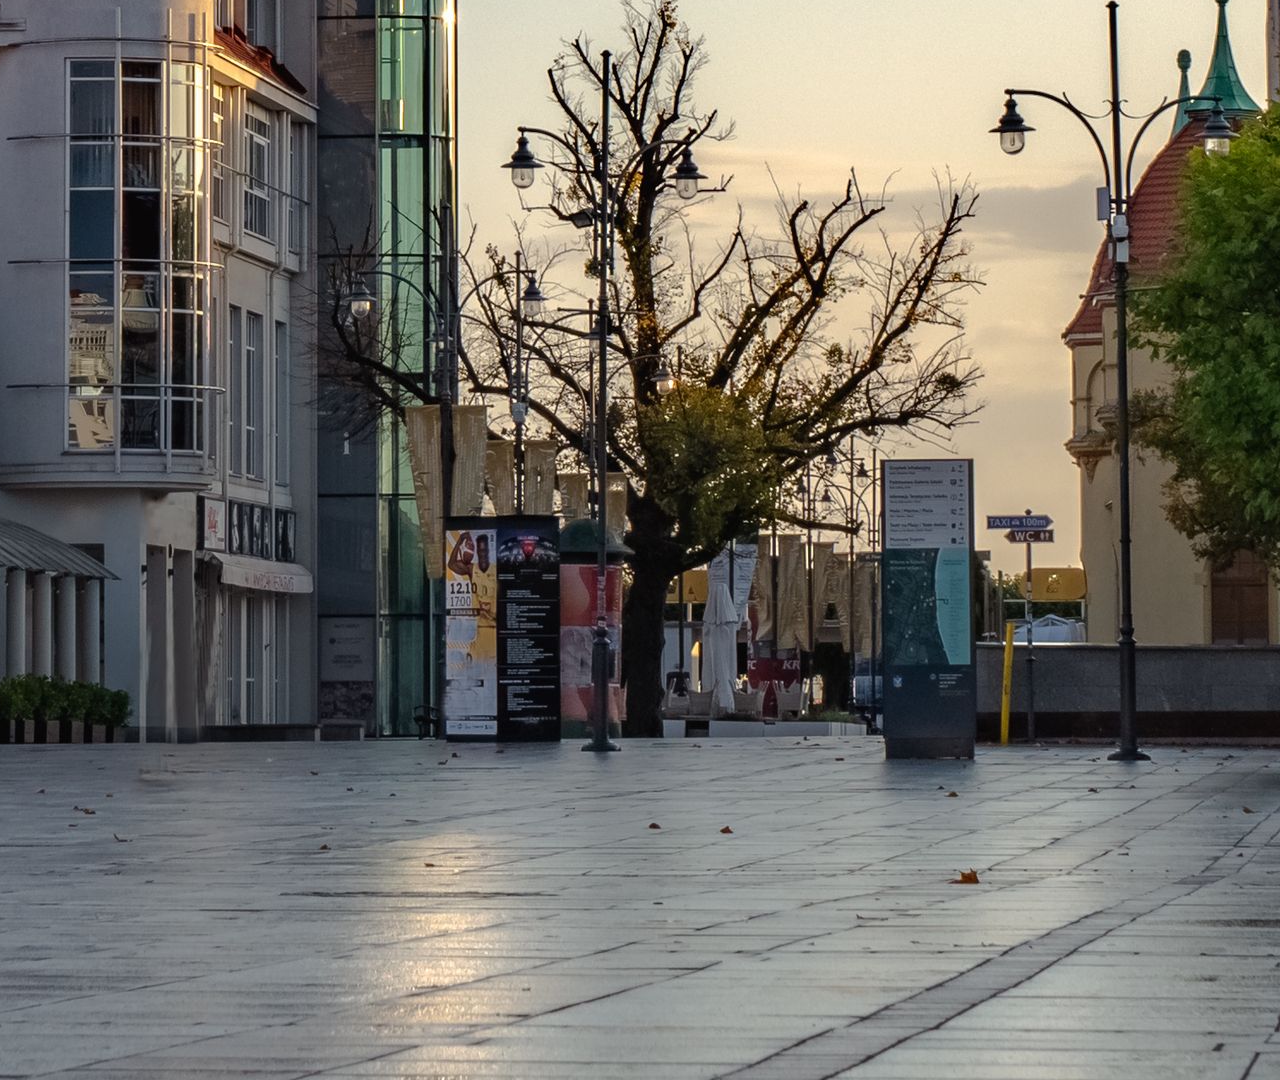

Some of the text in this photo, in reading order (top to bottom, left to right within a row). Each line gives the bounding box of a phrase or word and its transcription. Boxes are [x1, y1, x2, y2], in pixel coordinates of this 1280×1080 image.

[989, 518, 1046, 527] TAXI 100m
[1014, 531, 1035, 541] WC
[450, 582, 478, 594] 12.10
